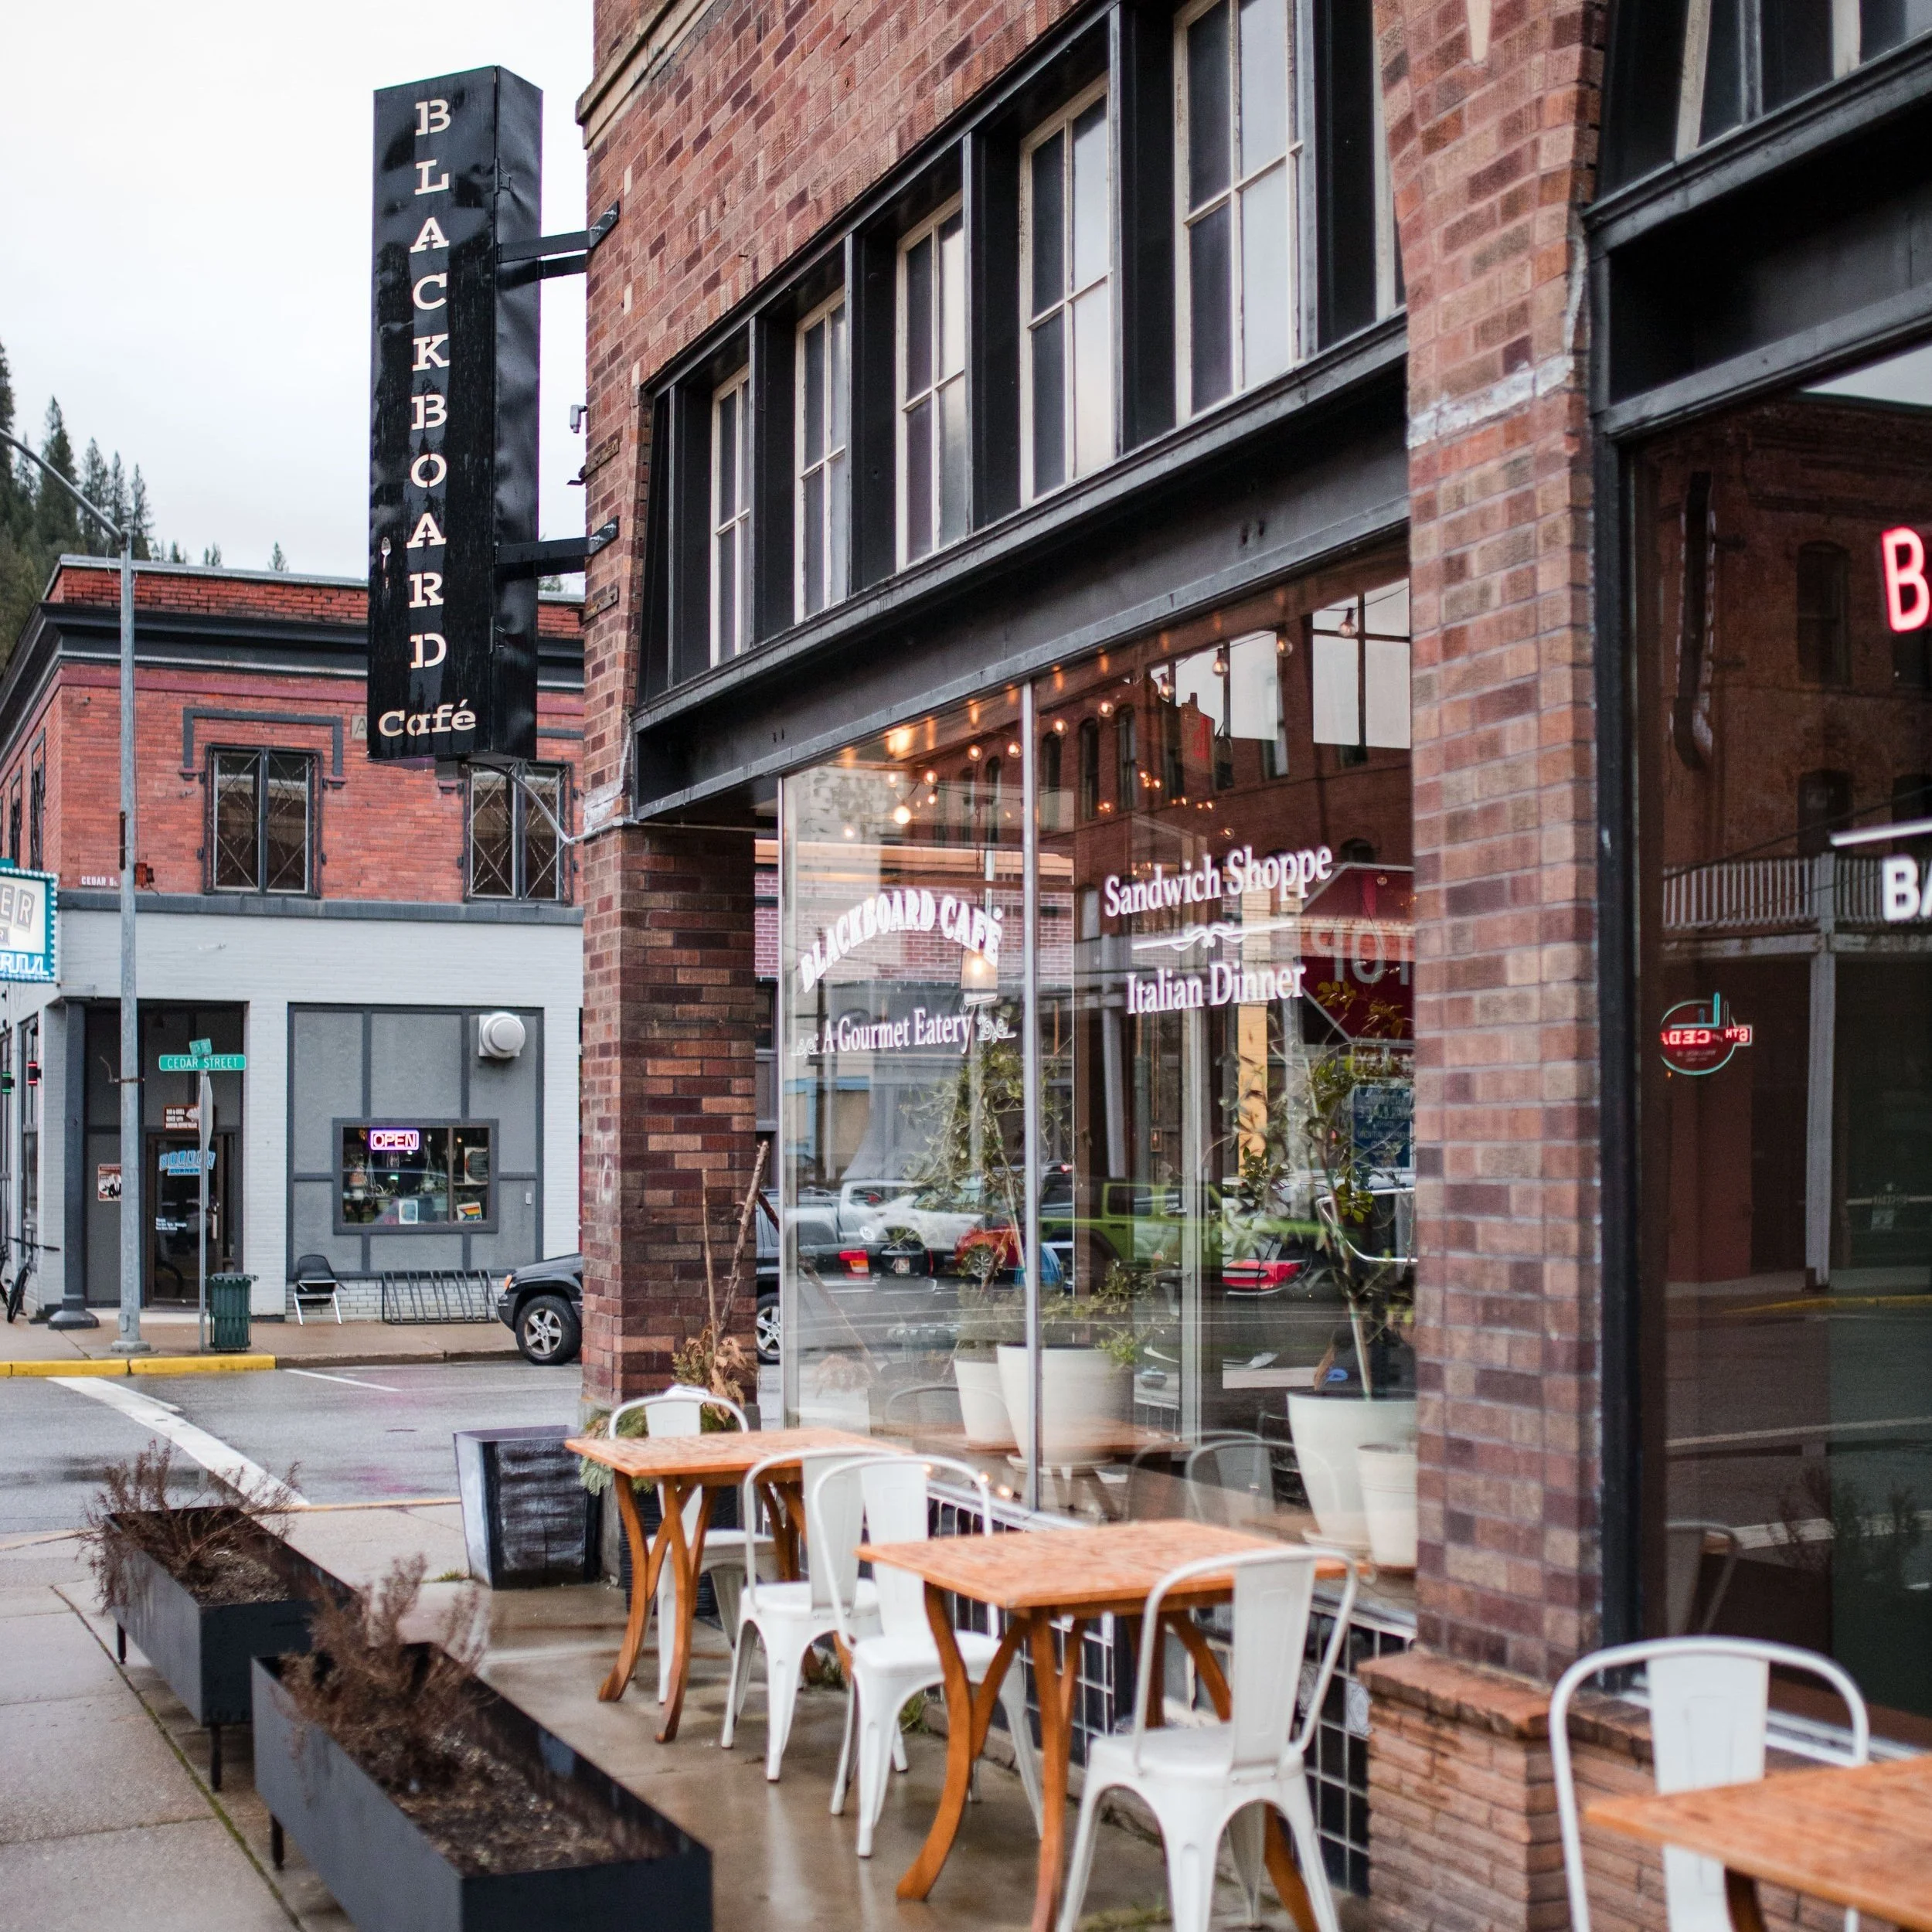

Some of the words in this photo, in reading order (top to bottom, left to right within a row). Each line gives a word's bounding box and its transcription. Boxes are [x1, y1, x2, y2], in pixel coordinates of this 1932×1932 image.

[406, 99, 451, 668] BLACKBOARD
[379, 699, 476, 737] Café
[81, 876, 107, 886] CEDAR
[1104, 855, 1221, 917] Sandwich
[1225, 845, 1333, 902] Shoppe
[799, 889, 936, 994] BLACKBOARD
[940, 895, 1003, 968] CAFÉ
[1127, 967, 1204, 1014] Italian
[1209, 961, 1307, 1005] Dinner
[821, 1022, 835, 1053] A
[837, 1015, 910, 1052] Gourmet
[913, 1007, 975, 1054] Eatery
[167, 1057, 199, 1069] CEDAR
[203, 1057, 238, 1069] STREET
[373, 1133, 417, 1148] OPEN
